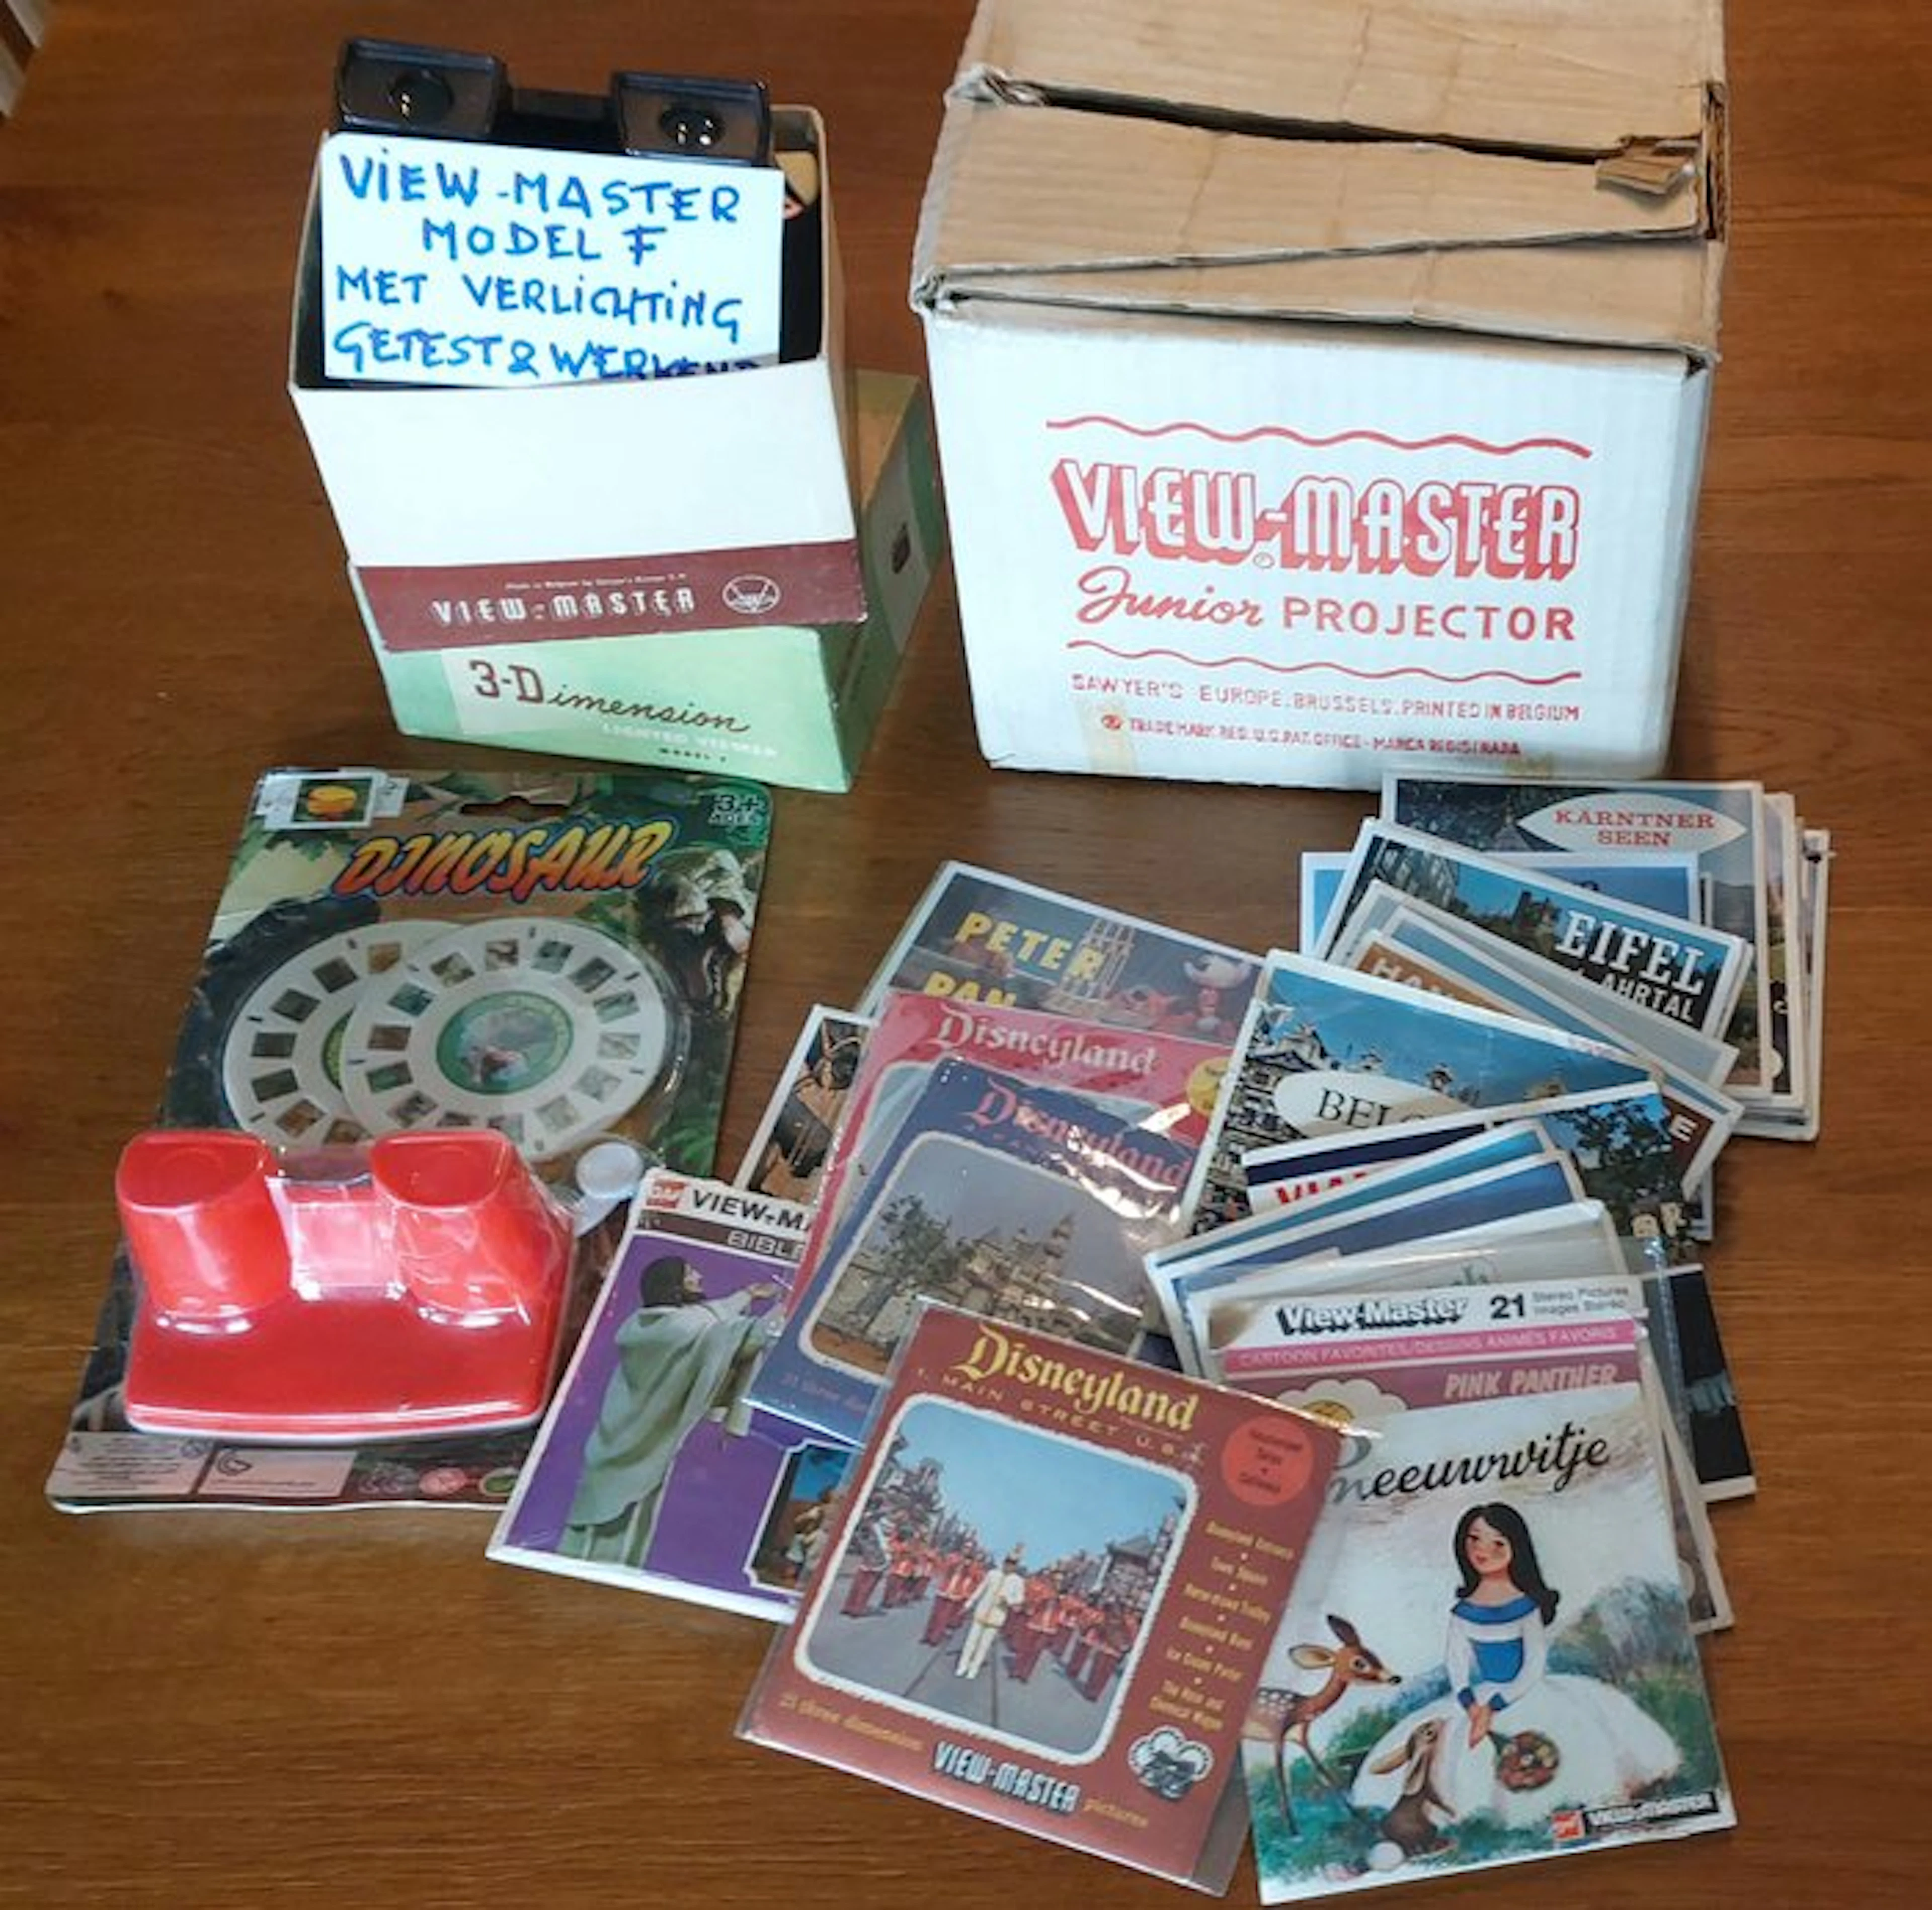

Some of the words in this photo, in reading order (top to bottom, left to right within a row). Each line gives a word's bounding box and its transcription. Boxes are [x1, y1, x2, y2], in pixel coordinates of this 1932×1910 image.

[423, 218, 602, 262] MODEL
[623, 224, 669, 266] F
[336, 266, 429, 304] MET
[463, 275, 744, 344] VERLICHTING
[1050, 458, 1580, 582] VIEW-MASTER
[431, 587, 696, 624] VIEW-MASTER
[1076, 566, 1264, 628] Junior
[1282, 595, 1576, 641] PROJECTOR
[468, 660, 750, 733] 3-Dimension
[1402, 698, 1479, 719] PRINTED
[1485, 702, 1502, 719] IN
[1508, 703, 1579, 722] BELGIUM
[334, 821, 673, 902] DINOSAUR
[1596, 830, 1672, 847] SEEN
[955, 911, 1107, 981] PETER
[1556, 910, 1705, 995] EIFEL
[924, 1003, 1158, 1074] Disneyland
[1276, 1294, 1469, 1336] View-Master
[1490, 1294, 1527, 1319] 21
[941, 1373, 1004, 1402] MAIN
[950, 1323, 1199, 1433] Disneyland
[1443, 1370, 1502, 1400] PINK
[1510, 1363, 1620, 1394] PANTHER
[932, 1741, 1081, 1815] VIEW-MASTER
